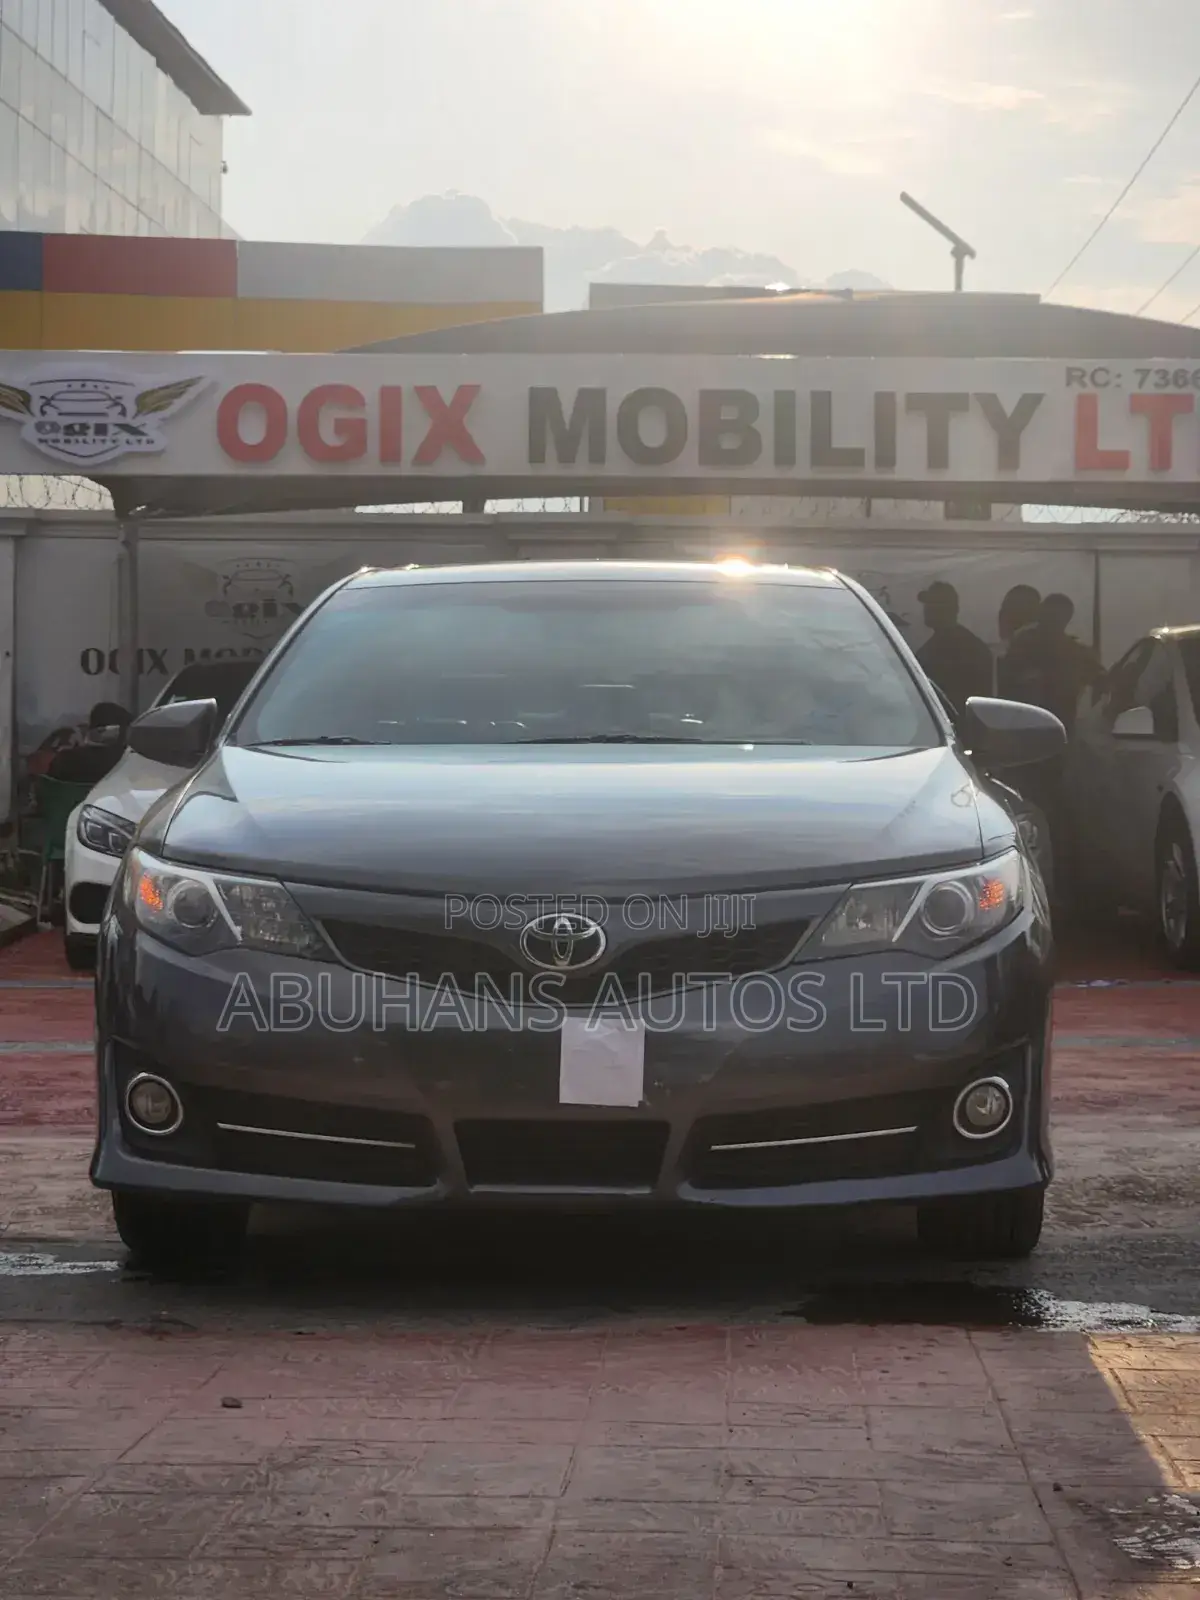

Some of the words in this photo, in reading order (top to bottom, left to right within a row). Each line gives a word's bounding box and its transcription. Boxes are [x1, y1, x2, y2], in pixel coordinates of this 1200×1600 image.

[1065, 366, 1122, 389] RC:
[217, 383, 486, 464] OGIX
[528, 386, 1044, 470] MOBILITY
